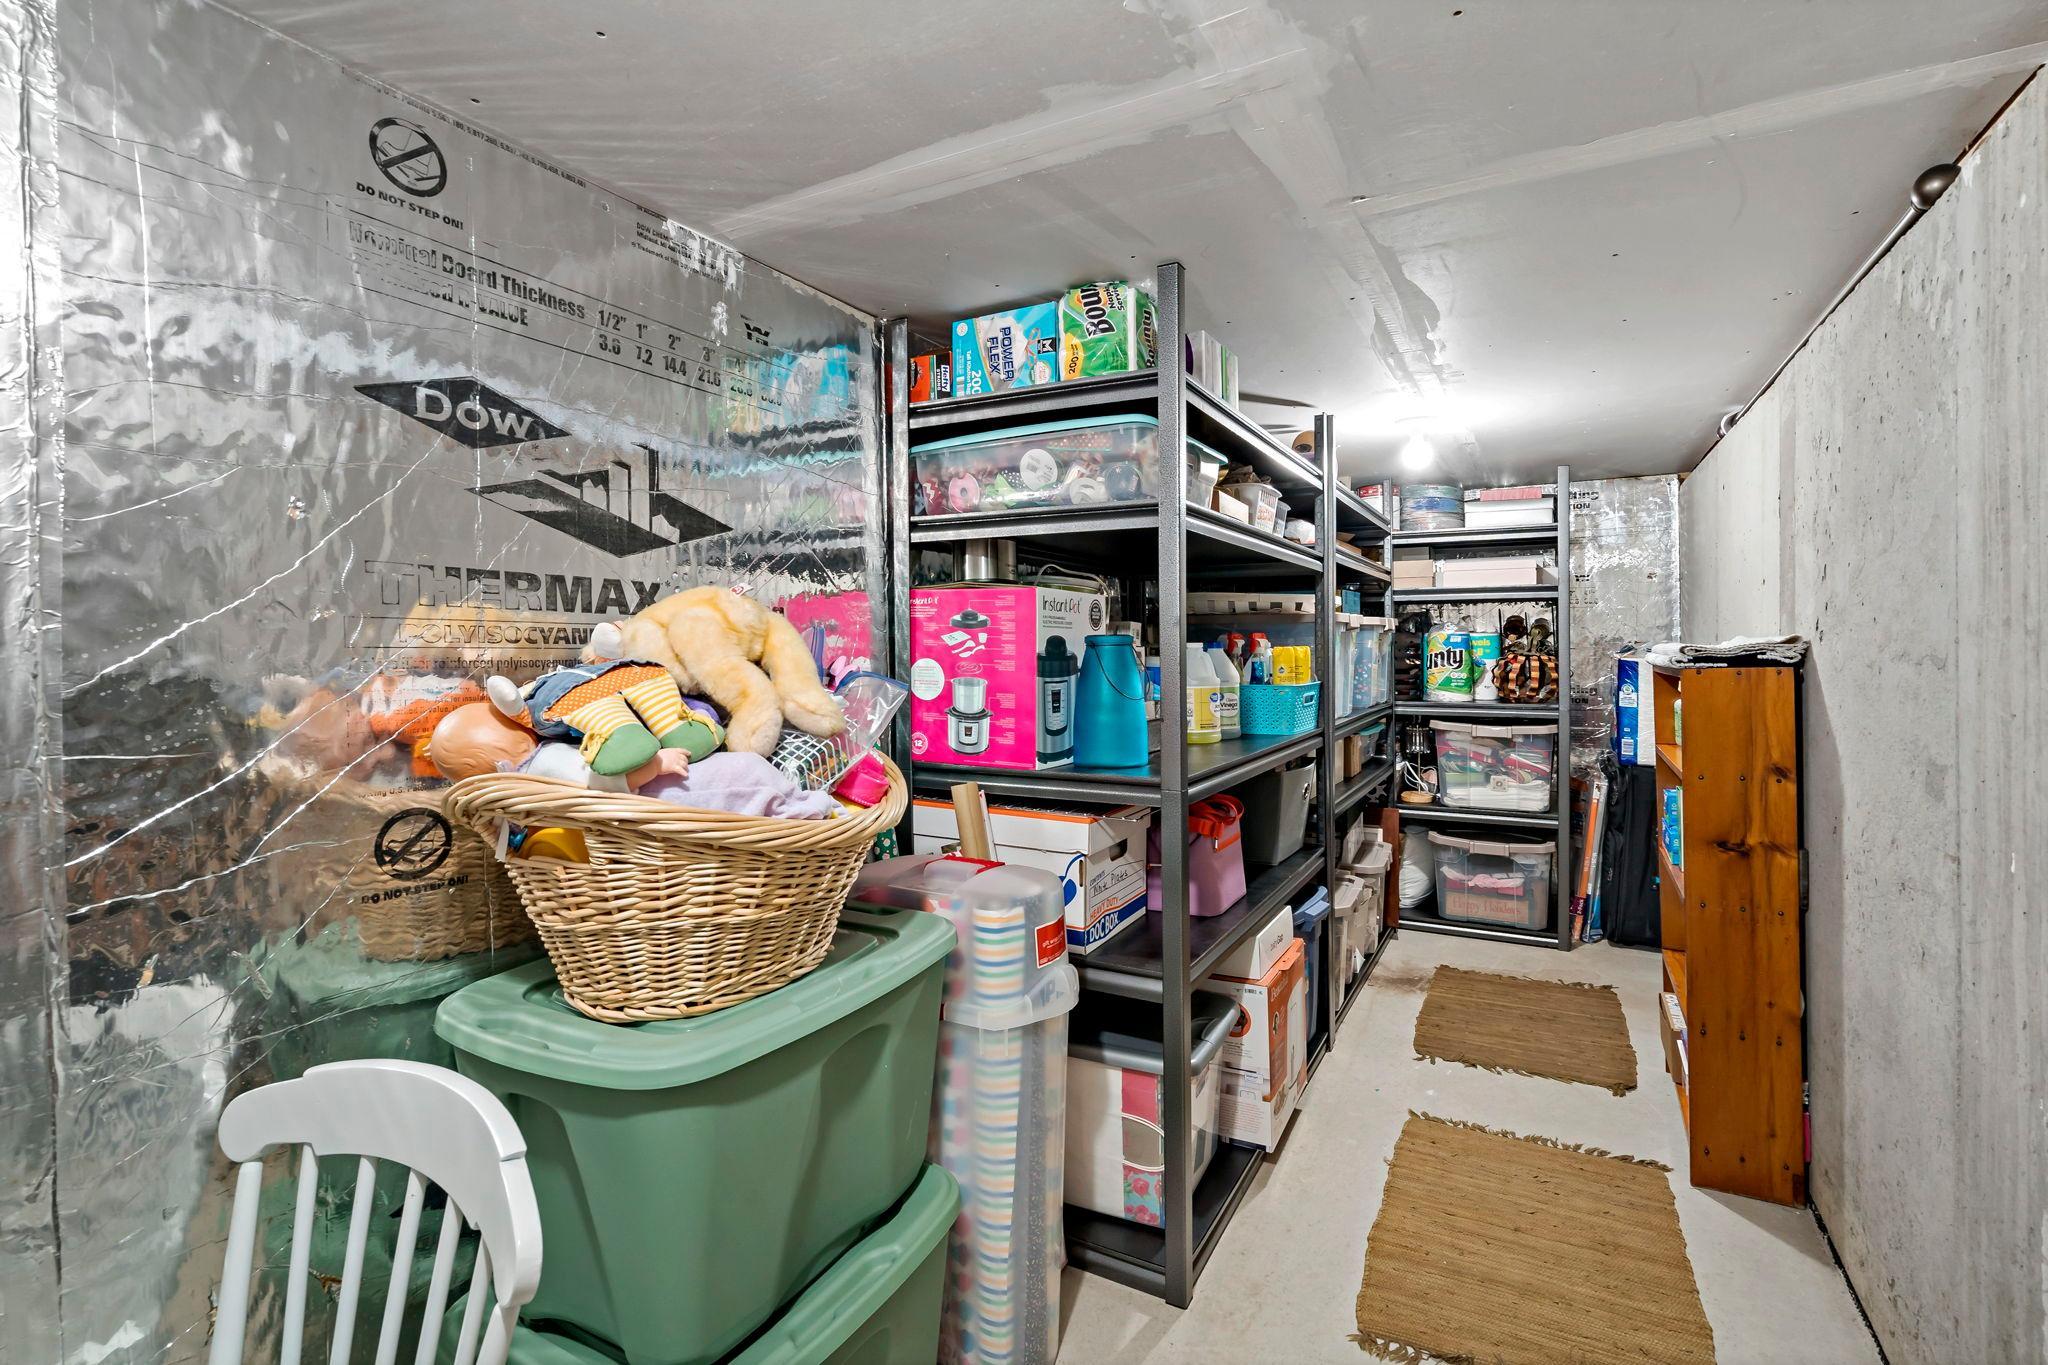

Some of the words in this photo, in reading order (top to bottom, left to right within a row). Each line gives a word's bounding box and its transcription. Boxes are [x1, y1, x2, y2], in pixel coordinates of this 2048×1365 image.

[355, 181, 375, 196] DO
[378, 189, 406, 207] NOT
[409, 201, 440, 220] STEP
[443, 215, 465, 231] ON!
[442, 253, 497, 289] Board
[501, 273, 586, 320] Thickness
[635, 346, 653, 366] 7.2
[663, 355, 688, 377] 14.4
[988, 336, 1000, 375] FLEX
[1000, 326, 1015, 382] POWER
[941, 365, 949, 391] Hefty
[364, 560, 662, 616] THERMAX
[1042, 595, 1068, 613] Instant
[399, 624, 595, 645] POLYISOCYAN
[1426, 646, 1465, 670] unty
[361, 893, 380, 905] DO
[383, 888, 410, 902] NOT
[1089, 917, 1105, 942] DOC
[1104, 911, 1119, 935] BOX
